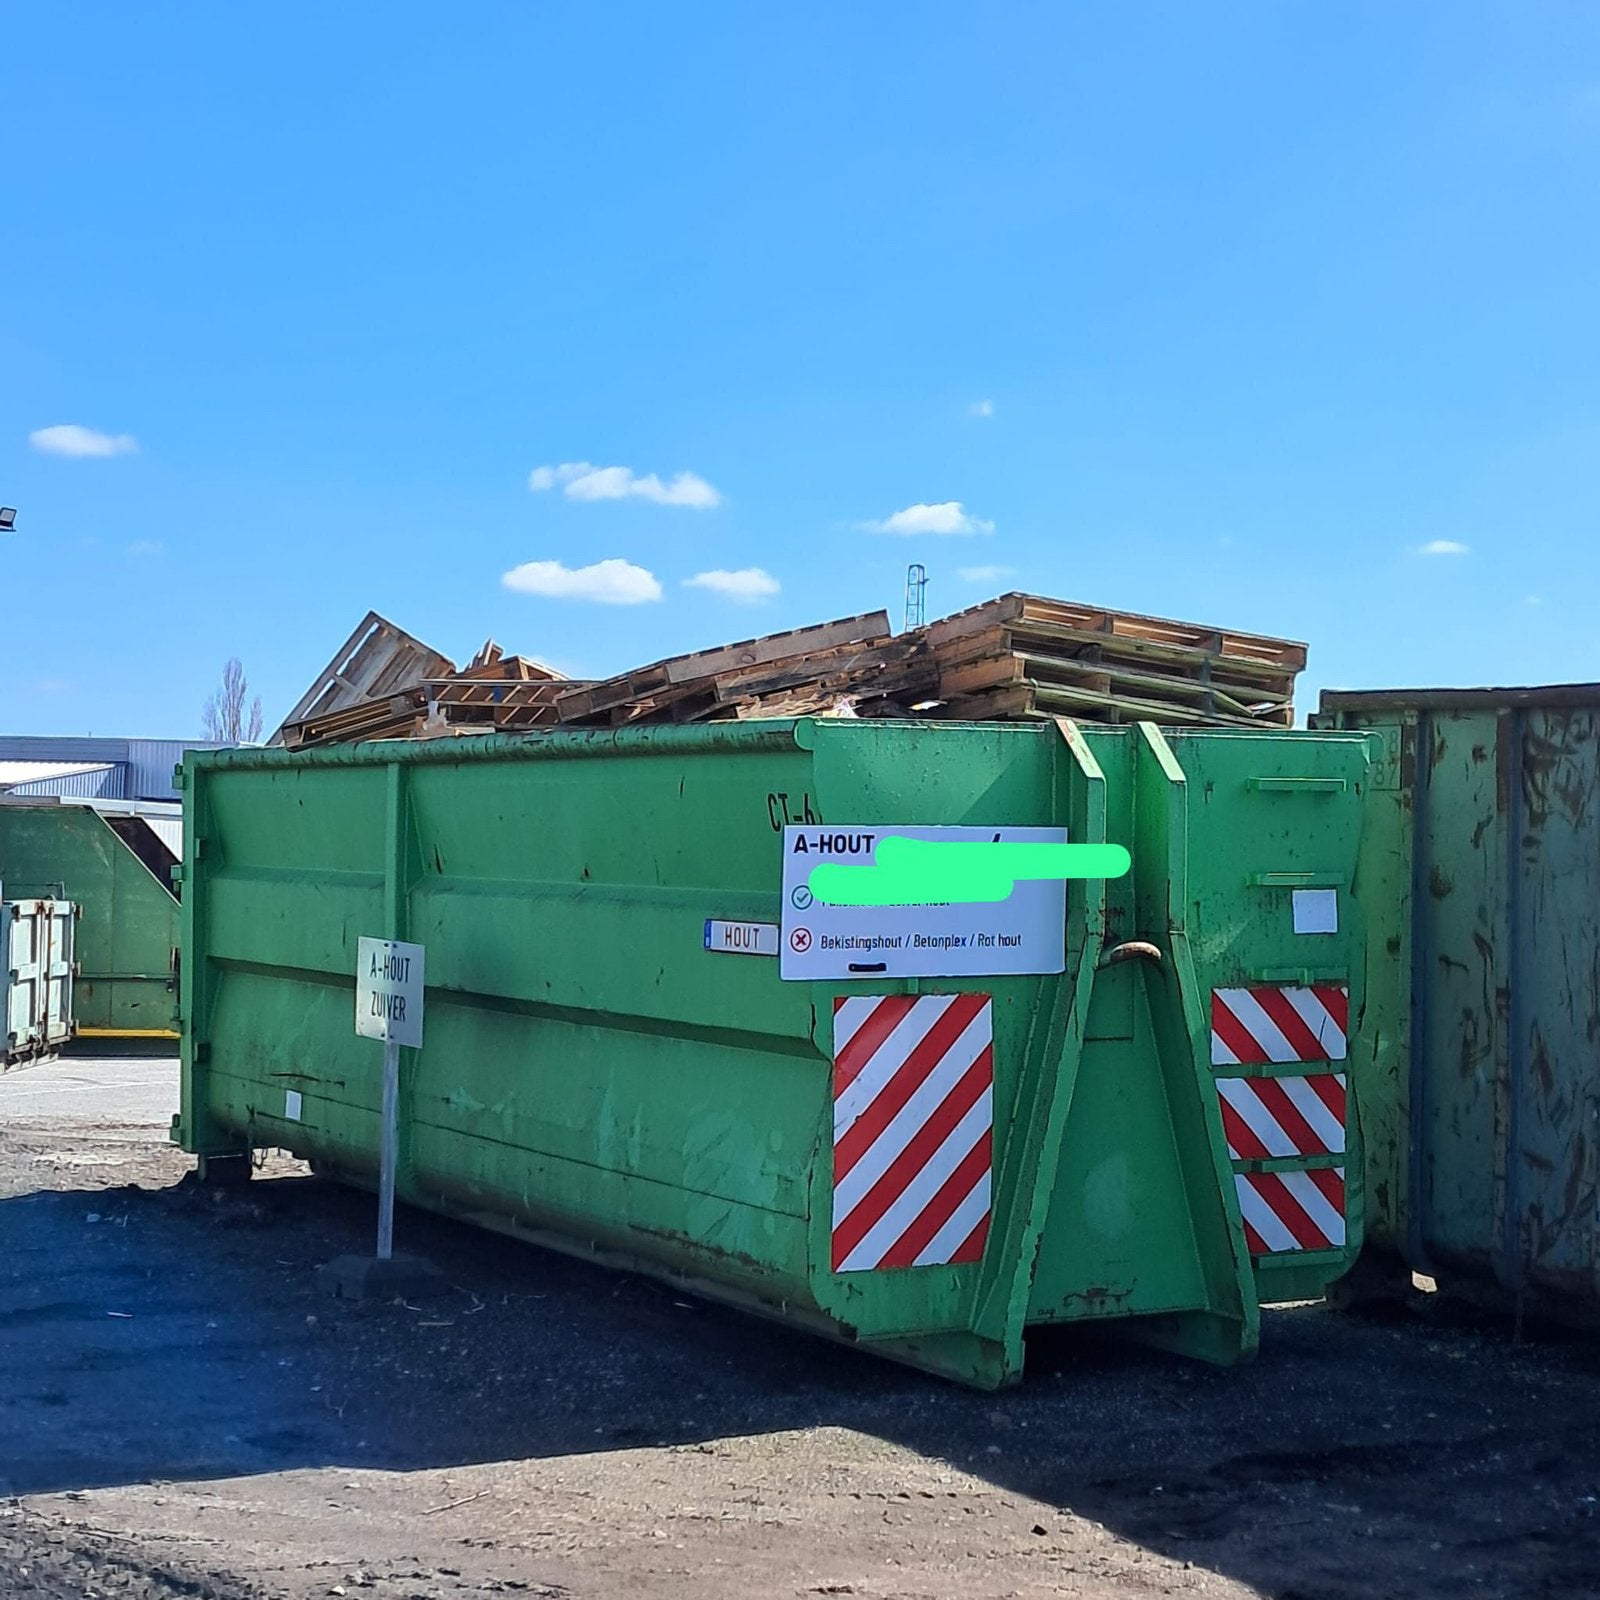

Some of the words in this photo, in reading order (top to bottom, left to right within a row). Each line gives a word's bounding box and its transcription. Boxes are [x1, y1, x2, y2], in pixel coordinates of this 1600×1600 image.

[793, 833, 875, 854] A-HOUT
[724, 926, 760, 949] HOUT
[820, 934, 902, 952] Bekistingshout
[913, 933, 967, 951] Betonplex
[978, 933, 996, 947] Rot
[998, 933, 1022, 947] hout
[370, 952, 410, 983] A-HOUT
[371, 990, 406, 1023] ZUIVER
